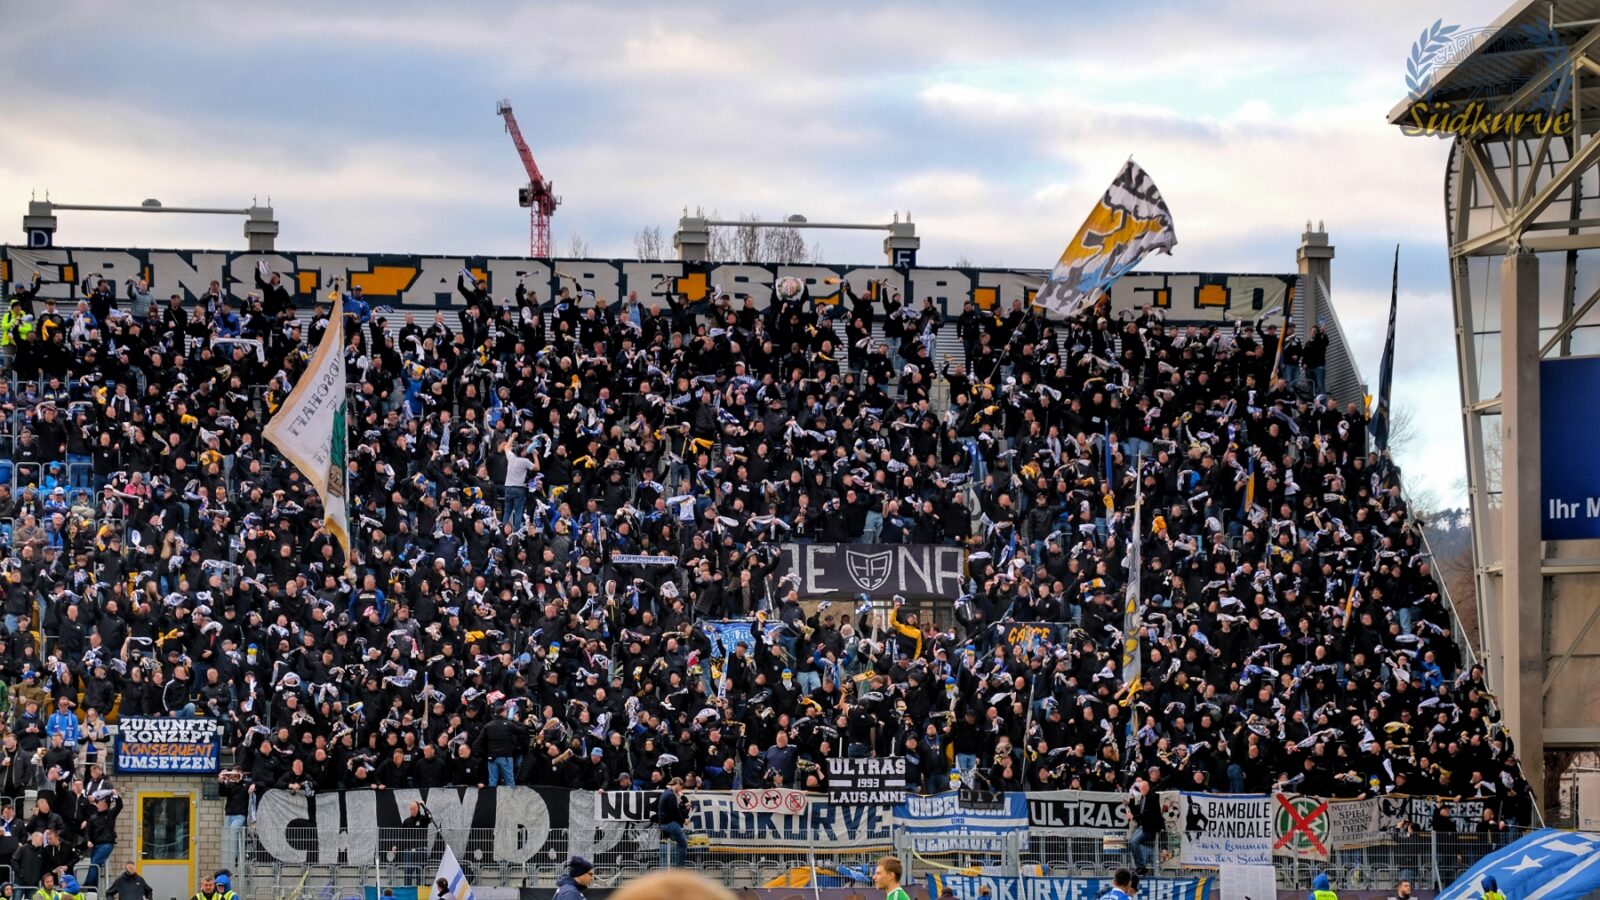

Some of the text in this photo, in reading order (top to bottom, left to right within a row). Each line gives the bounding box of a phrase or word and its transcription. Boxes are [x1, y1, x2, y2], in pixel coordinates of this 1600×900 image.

[31, 230, 48, 247] D
[7, 248, 1288, 322] ERNST ABBE SPORTELD
[1549, 498, 1580, 519] Ihr
[120, 718, 217, 731] ZUKUNFTS
[124, 730, 214, 743] KONZEPT
[121, 743, 214, 757] KONSEQUENT
[119, 755, 216, 769] UMSETZEN
[829, 759, 906, 775] ULTRAS
[857, 778, 879, 788] 1993
[830, 791, 906, 803] LAUSANNE
[1030, 800, 1130, 828] ULTRAS
[1208, 801, 1271, 819] BAMBULE
[1338, 809, 1369, 819] SPIEL
[1411, 799, 1485, 817] REFGEES
[690, 799, 890, 841] ÜDKURVE
[1208, 821, 1271, 838] RANDALE
[1342, 824, 1368, 833] DEIN
[1225, 840, 1269, 852] kommen
